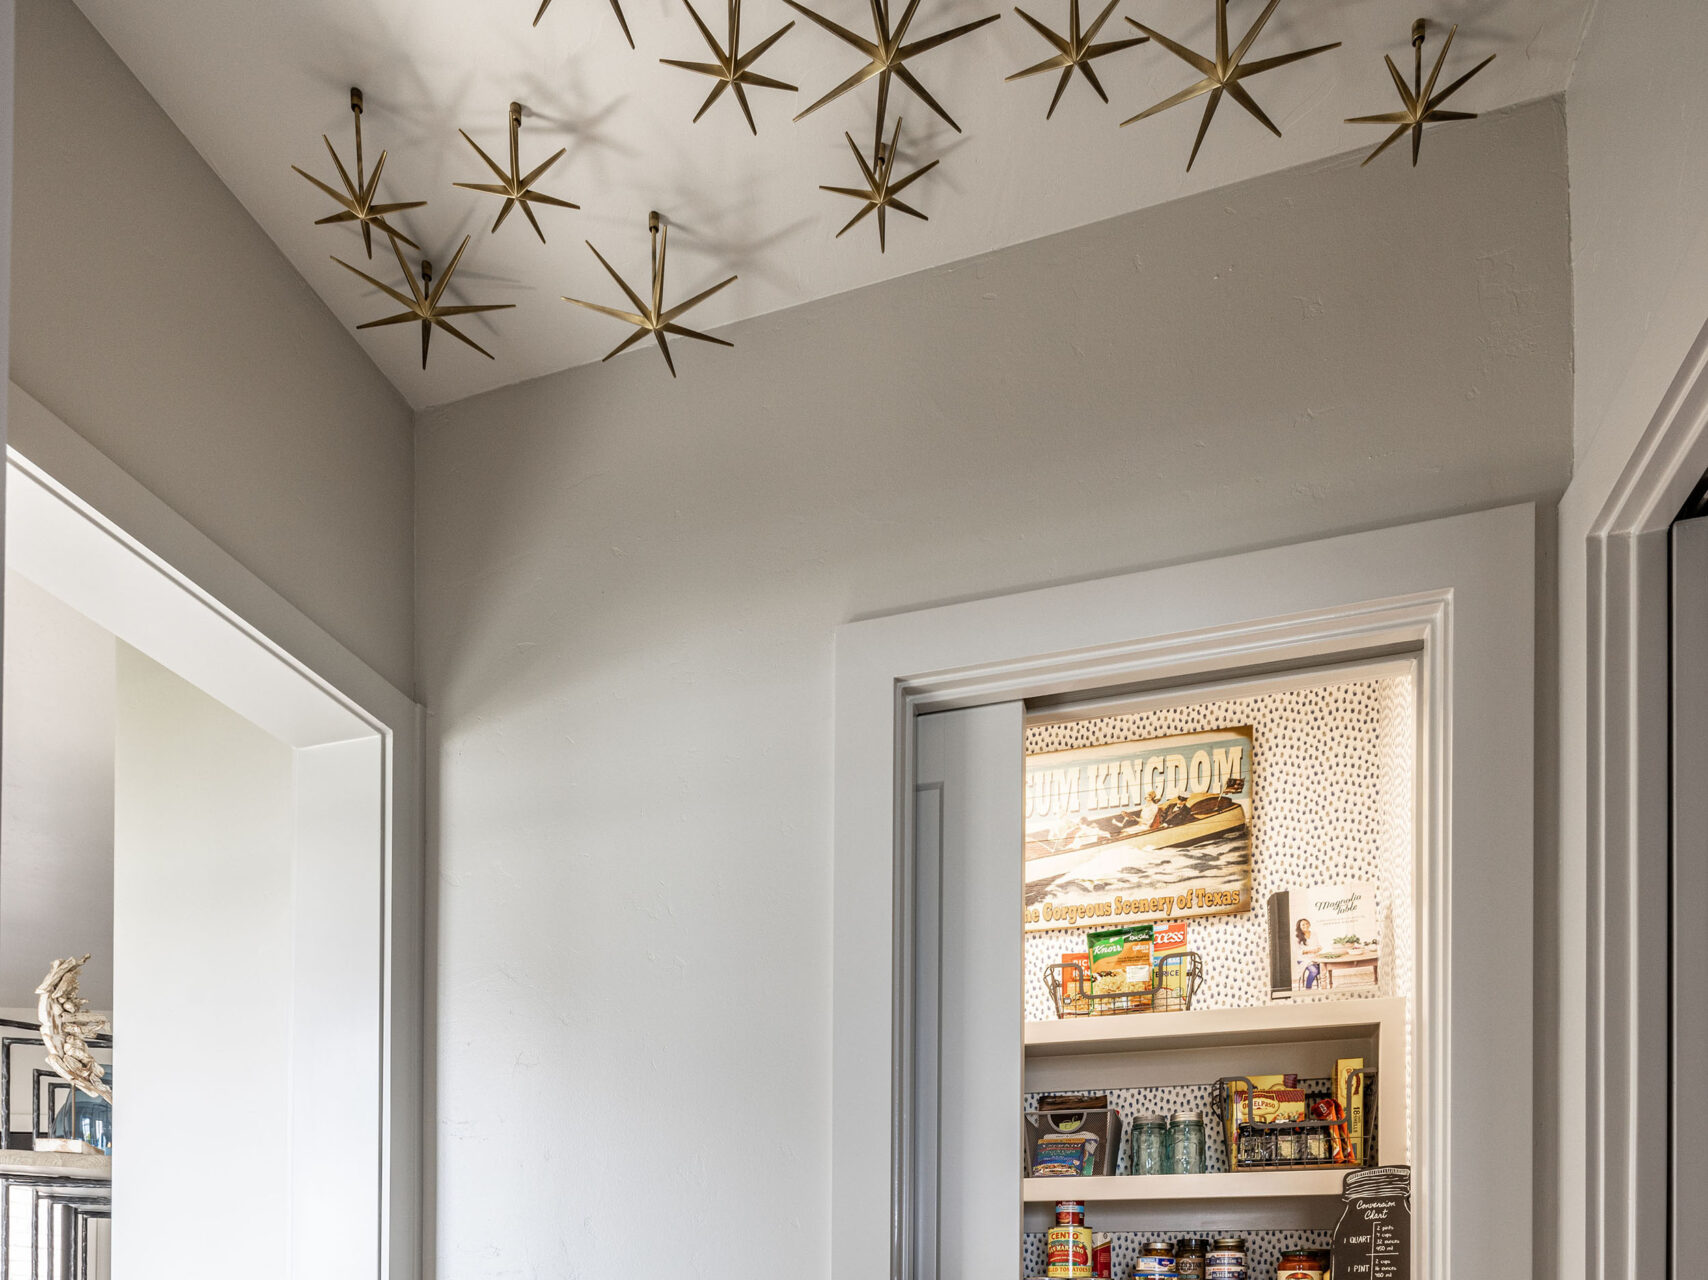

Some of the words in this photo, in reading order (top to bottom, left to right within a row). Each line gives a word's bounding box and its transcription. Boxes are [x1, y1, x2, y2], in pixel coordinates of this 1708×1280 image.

[1087, 746, 1244, 810] KINGDOM
[1042, 902, 1112, 924] Gorgeous
[1114, 895, 1175, 916] Scenery
[1177, 891, 1194, 909] of
[1195, 889, 1241, 908] Texas
[1093, 944, 1123, 956] Knorr
[1356, 1200, 1396, 1210] Conversion
[1364, 1208, 1389, 1220] Chart
[1050, 1231, 1079, 1240] CENTO
[1349, 1235, 1371, 1244] QUART
[1353, 1264, 1370, 1273] PINT
